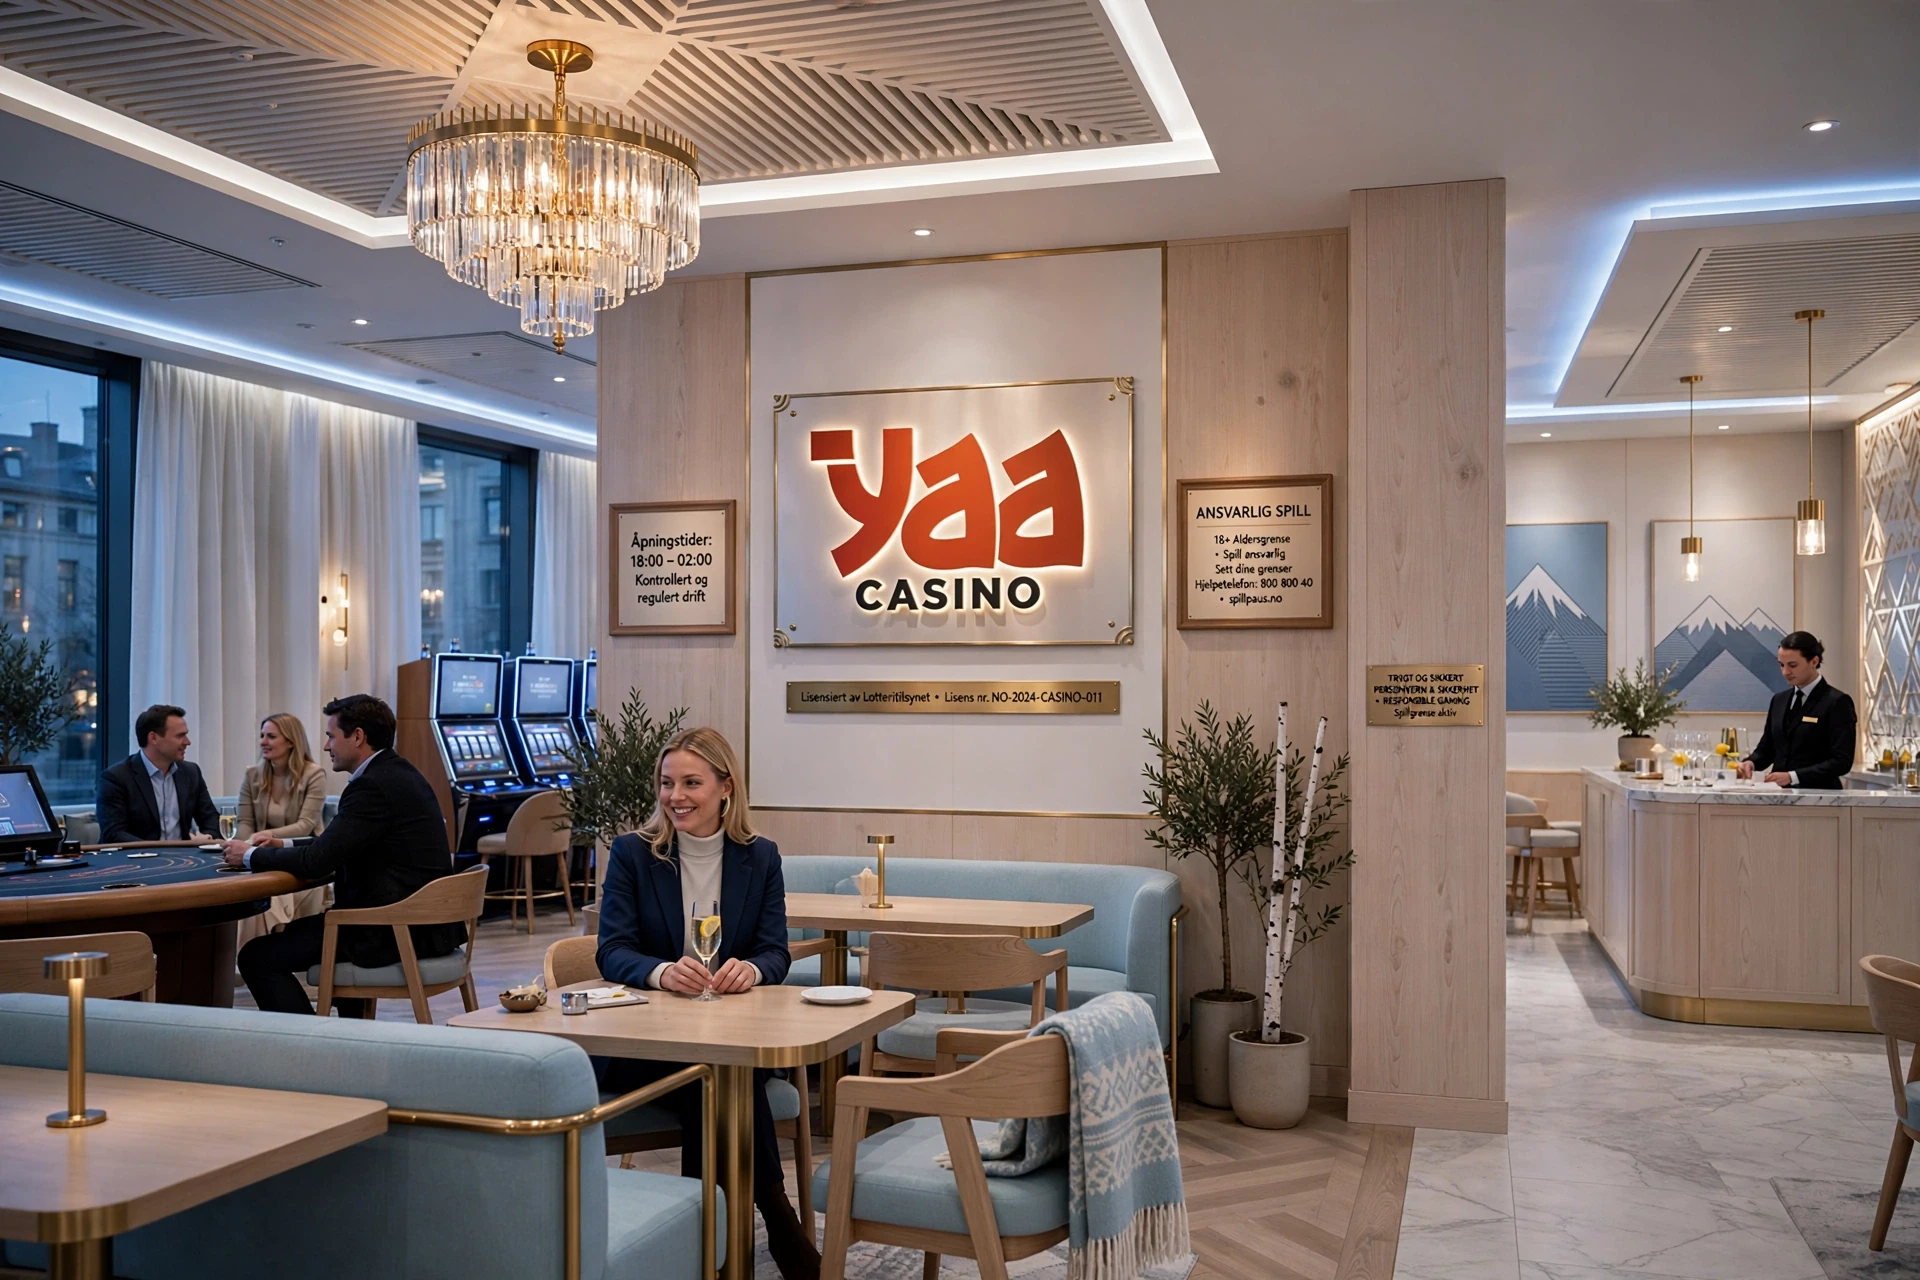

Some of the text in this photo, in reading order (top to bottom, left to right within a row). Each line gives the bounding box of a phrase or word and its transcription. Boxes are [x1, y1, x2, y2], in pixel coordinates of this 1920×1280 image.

[1196, 504, 1311, 519] ANSVARLIG SPILL
[631, 532, 712, 551] Åpningstider:
[1214, 534, 1290, 546] 18+ Aldersgrense
[631, 554, 664, 568] 18:00
[677, 553, 712, 566] 02:00
[1224, 548, 1242, 561] Spill
[1216, 564, 1292, 576] Sett dine grenser
[636, 572, 708, 588] Kontrollert og
[1195, 578, 1313, 592] Hjelpetelefon: 800 800 40
[638, 590, 706, 606] regulert drift
[856, 576, 1040, 611] CASINO
[1229, 593, 1282, 606] spillpaus.no
[1416, 674, 1428, 682] OG
[801, 692, 1102, 706] Lisensiert av Lotteritilsynet Lisens nr. NO-2024-CASINO-011
